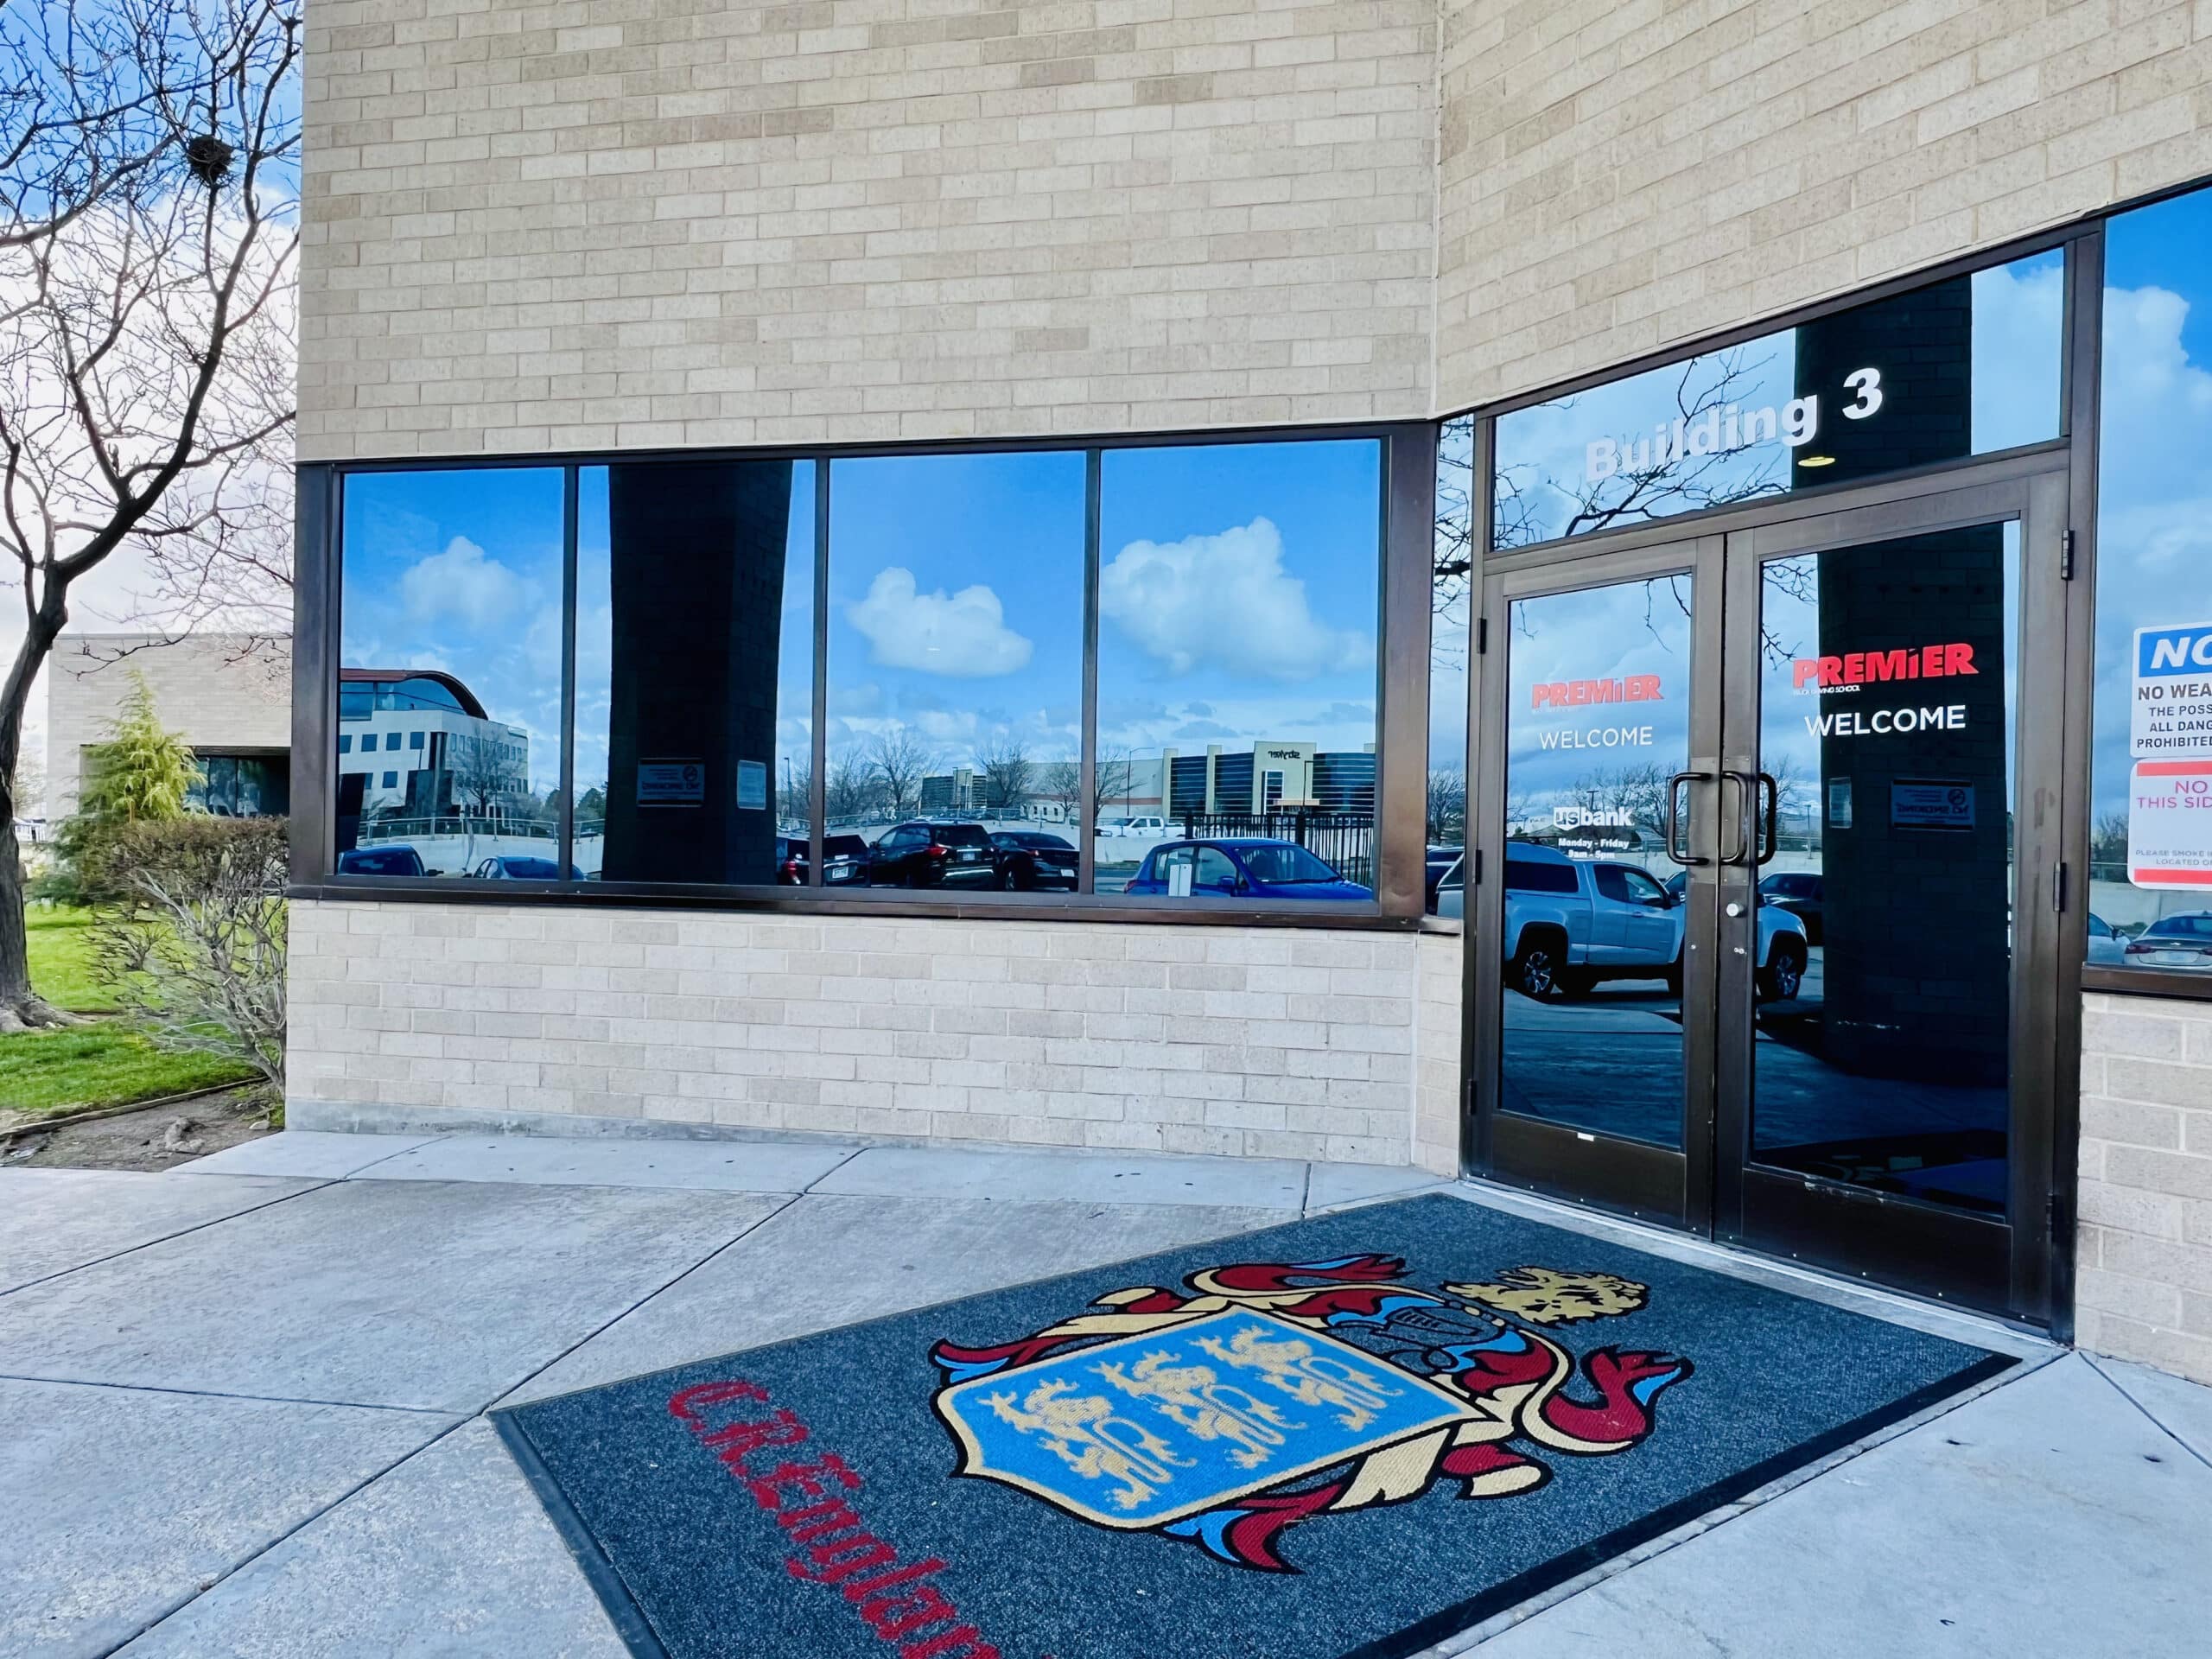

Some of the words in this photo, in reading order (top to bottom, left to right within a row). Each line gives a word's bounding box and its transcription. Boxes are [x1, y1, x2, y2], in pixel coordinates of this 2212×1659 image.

[1586, 394, 1817, 484] Building
[1842, 367, 1884, 420] 3
[2139, 686, 2164, 701] NO
[2171, 683, 2212, 699] WEA
[2149, 706, 2175, 717] THE
[1804, 705, 1966, 737] WELCOME
[2150, 721, 2173, 733] ALL
[1540, 726, 1653, 750] WELCOME
[2175, 780, 2208, 794] NO
[2137, 798, 2177, 809] THIS
[1558, 838, 1592, 849] Monday
[1600, 839, 1630, 849] Friday
[1595, 850, 1615, 860] 5pm
